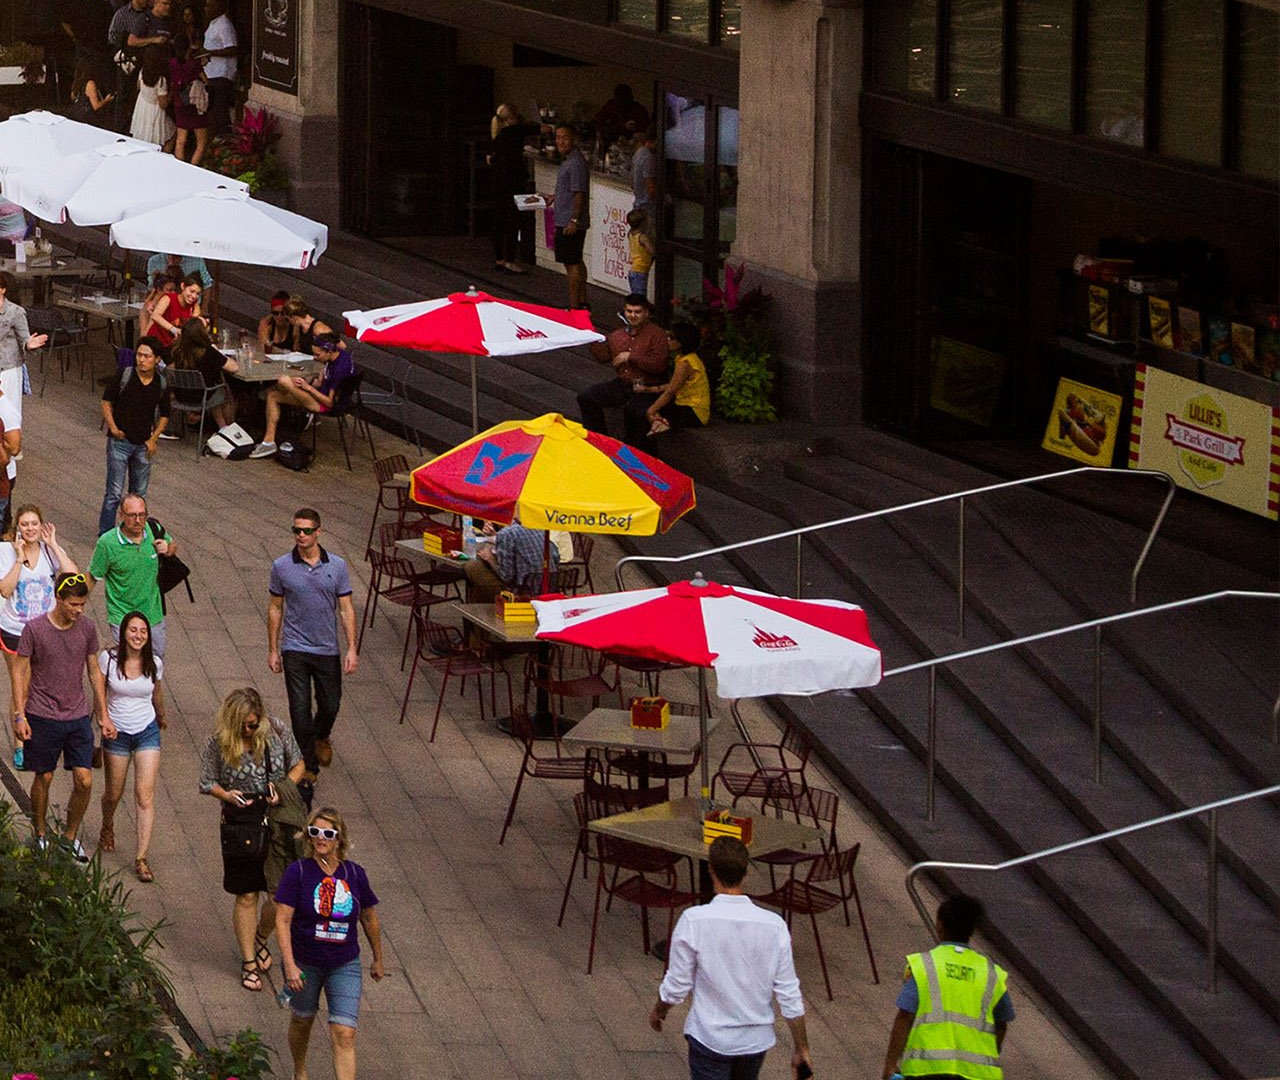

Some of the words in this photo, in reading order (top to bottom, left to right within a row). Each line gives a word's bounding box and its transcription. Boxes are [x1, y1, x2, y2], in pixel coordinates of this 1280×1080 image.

[602, 204, 628, 225] you
[1183, 429, 1202, 447] Park
[1204, 437, 1225, 454] Grill
[544, 509, 596, 526] Vienna
[598, 512, 633, 531] Beef
[945, 962, 976, 984] SECURITY
